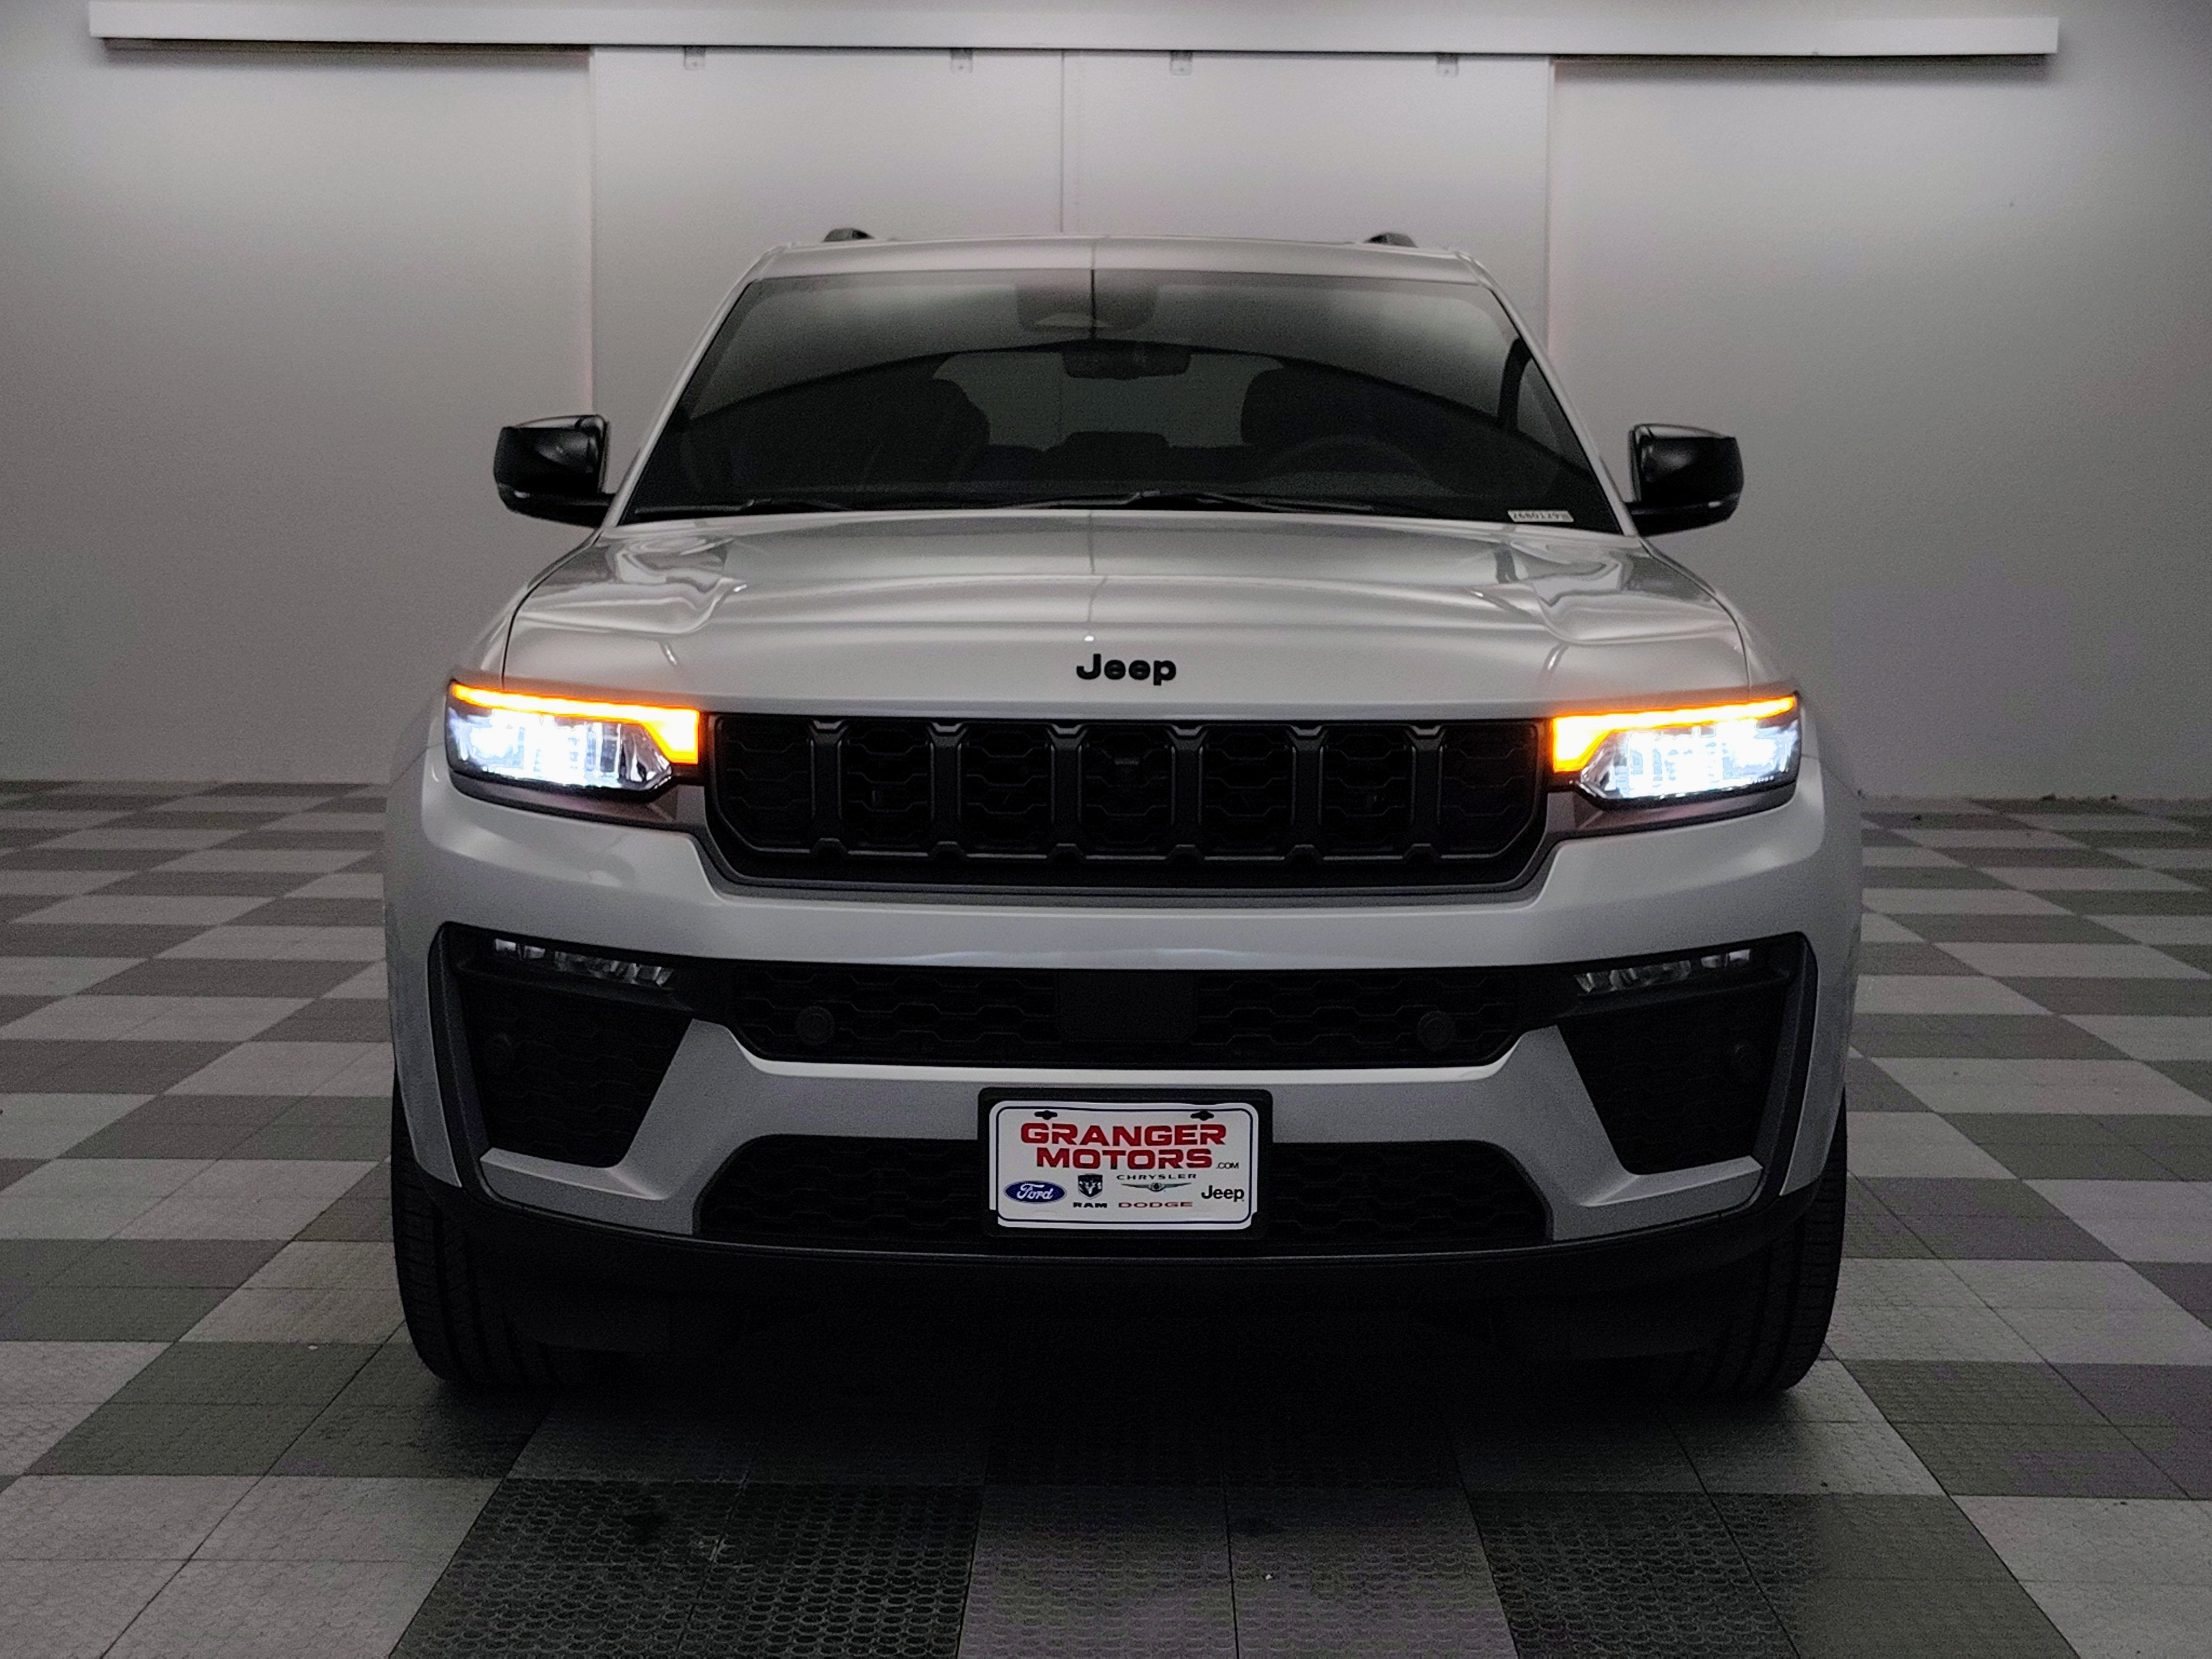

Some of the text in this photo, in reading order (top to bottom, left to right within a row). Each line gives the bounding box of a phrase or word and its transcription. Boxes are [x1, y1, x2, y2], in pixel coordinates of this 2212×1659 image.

[1076, 653, 1177, 686] Jeep
[1021, 1123, 1226, 1146] GRANGER
[1036, 1148, 1212, 1170] MOTORS
[1016, 1183, 1054, 1201] Ford
[1201, 1185, 1245, 1202] Jeep
